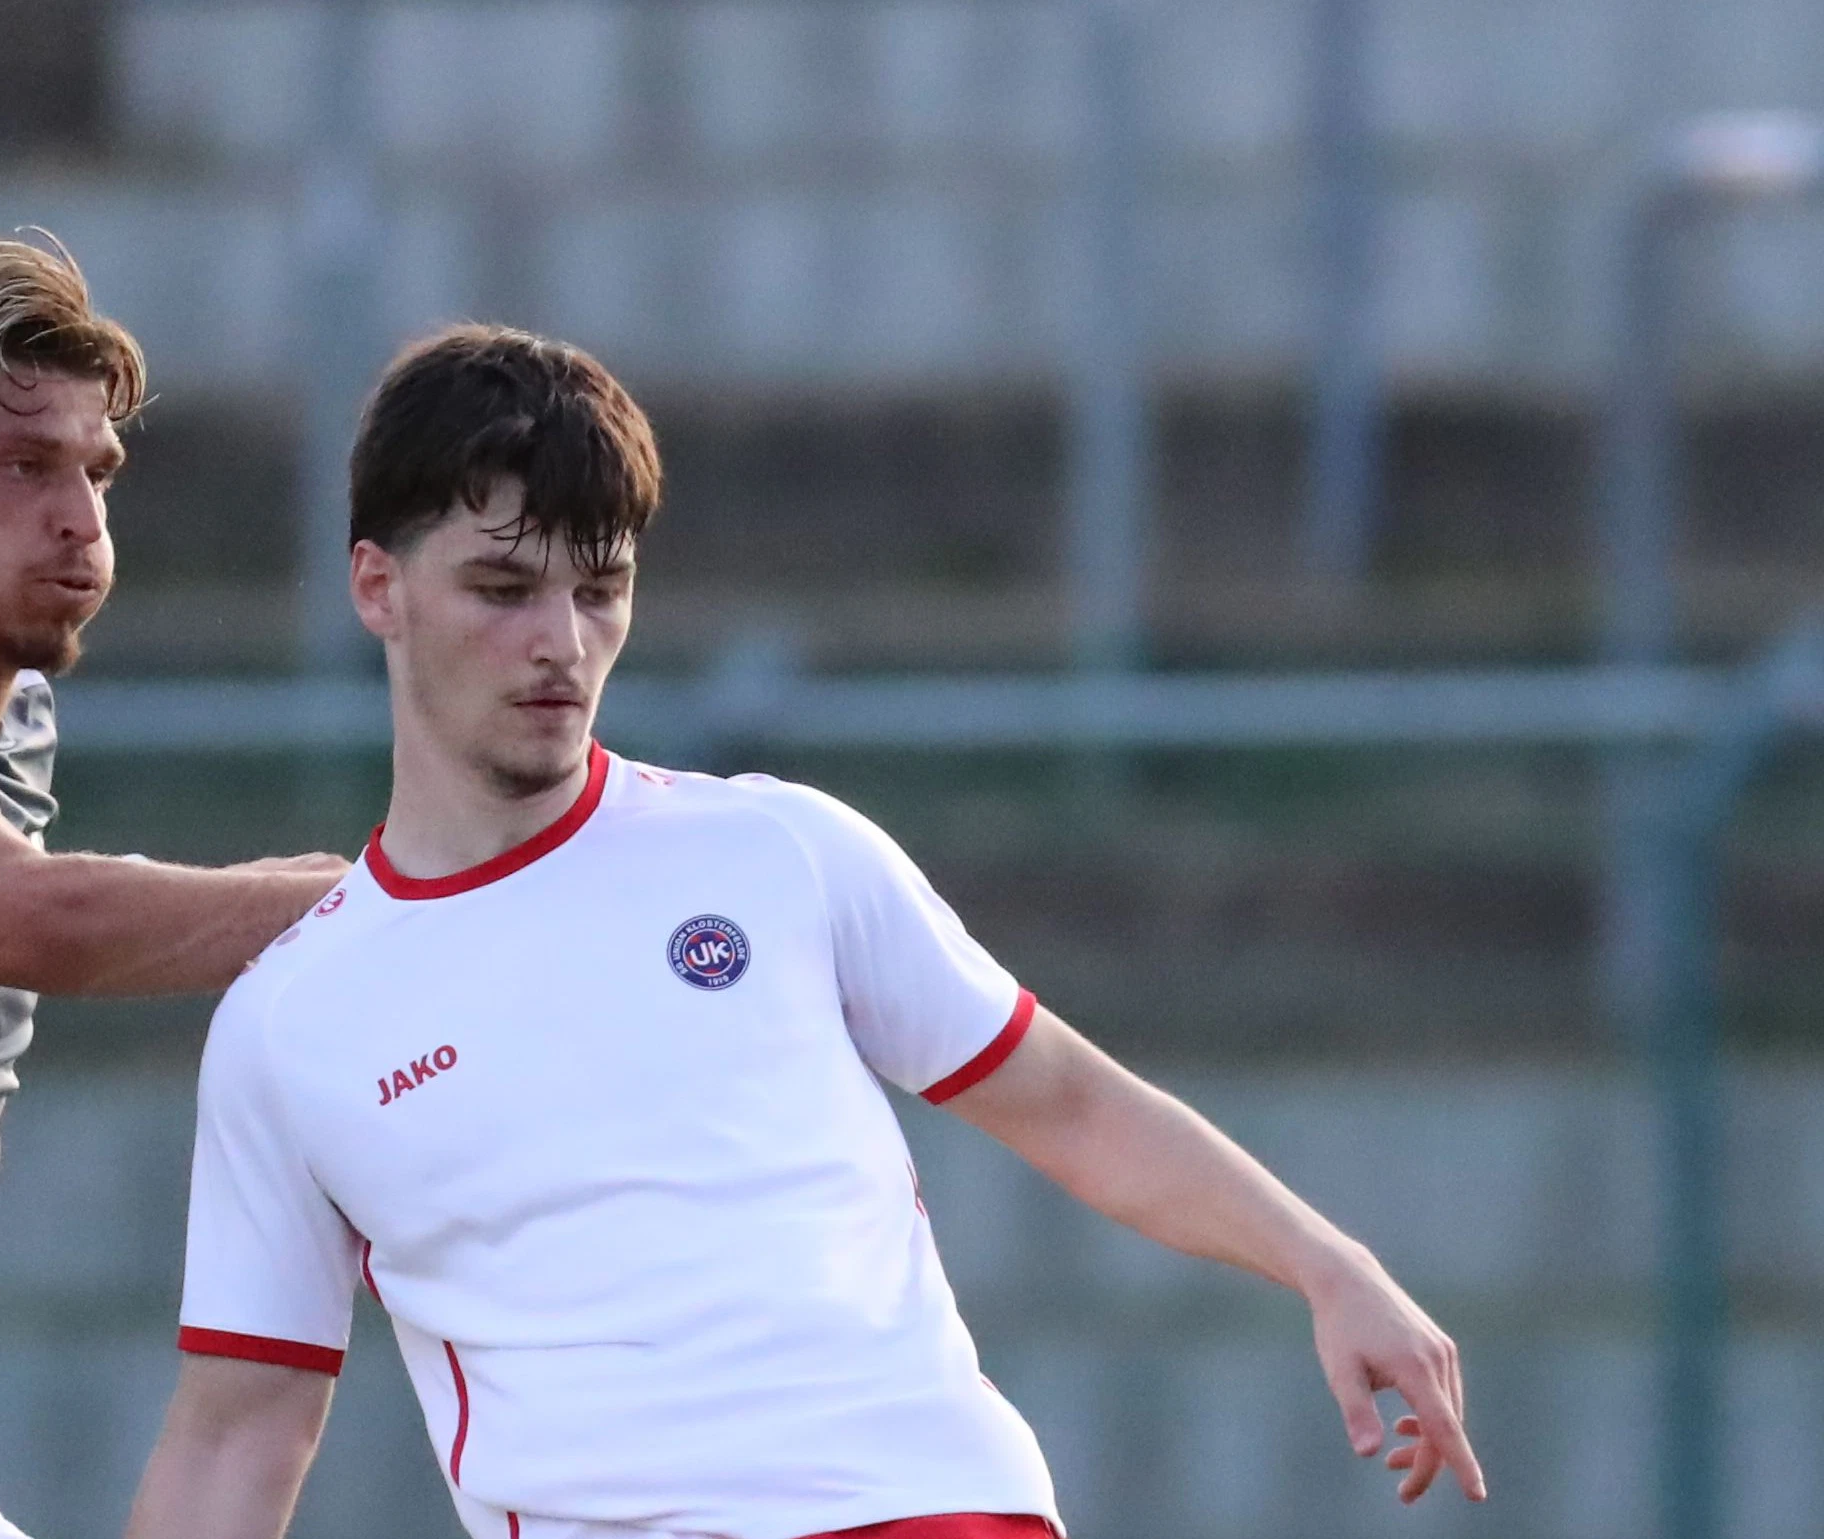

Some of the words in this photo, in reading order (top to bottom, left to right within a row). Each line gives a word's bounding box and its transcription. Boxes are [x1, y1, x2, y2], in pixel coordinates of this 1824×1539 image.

[672, 931, 688, 961] UNION
[688, 940, 730, 966] UK
[377, 1044, 459, 1107] JAKO
